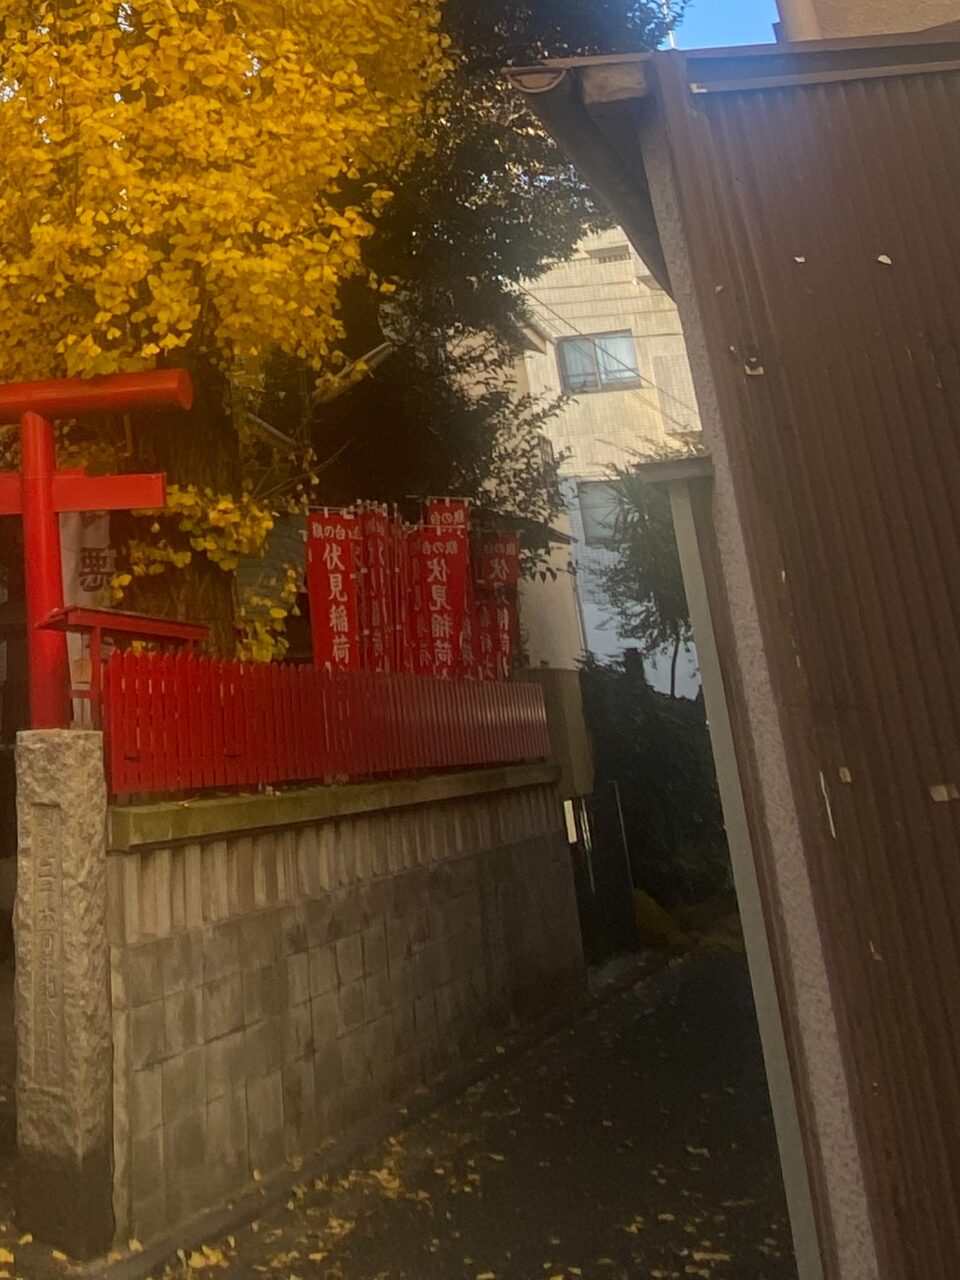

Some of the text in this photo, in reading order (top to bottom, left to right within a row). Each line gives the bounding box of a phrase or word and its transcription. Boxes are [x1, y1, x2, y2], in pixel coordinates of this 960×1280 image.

[311, 521, 346, 540] 旗の台
[322, 541, 352, 671] 伏見稲荷
